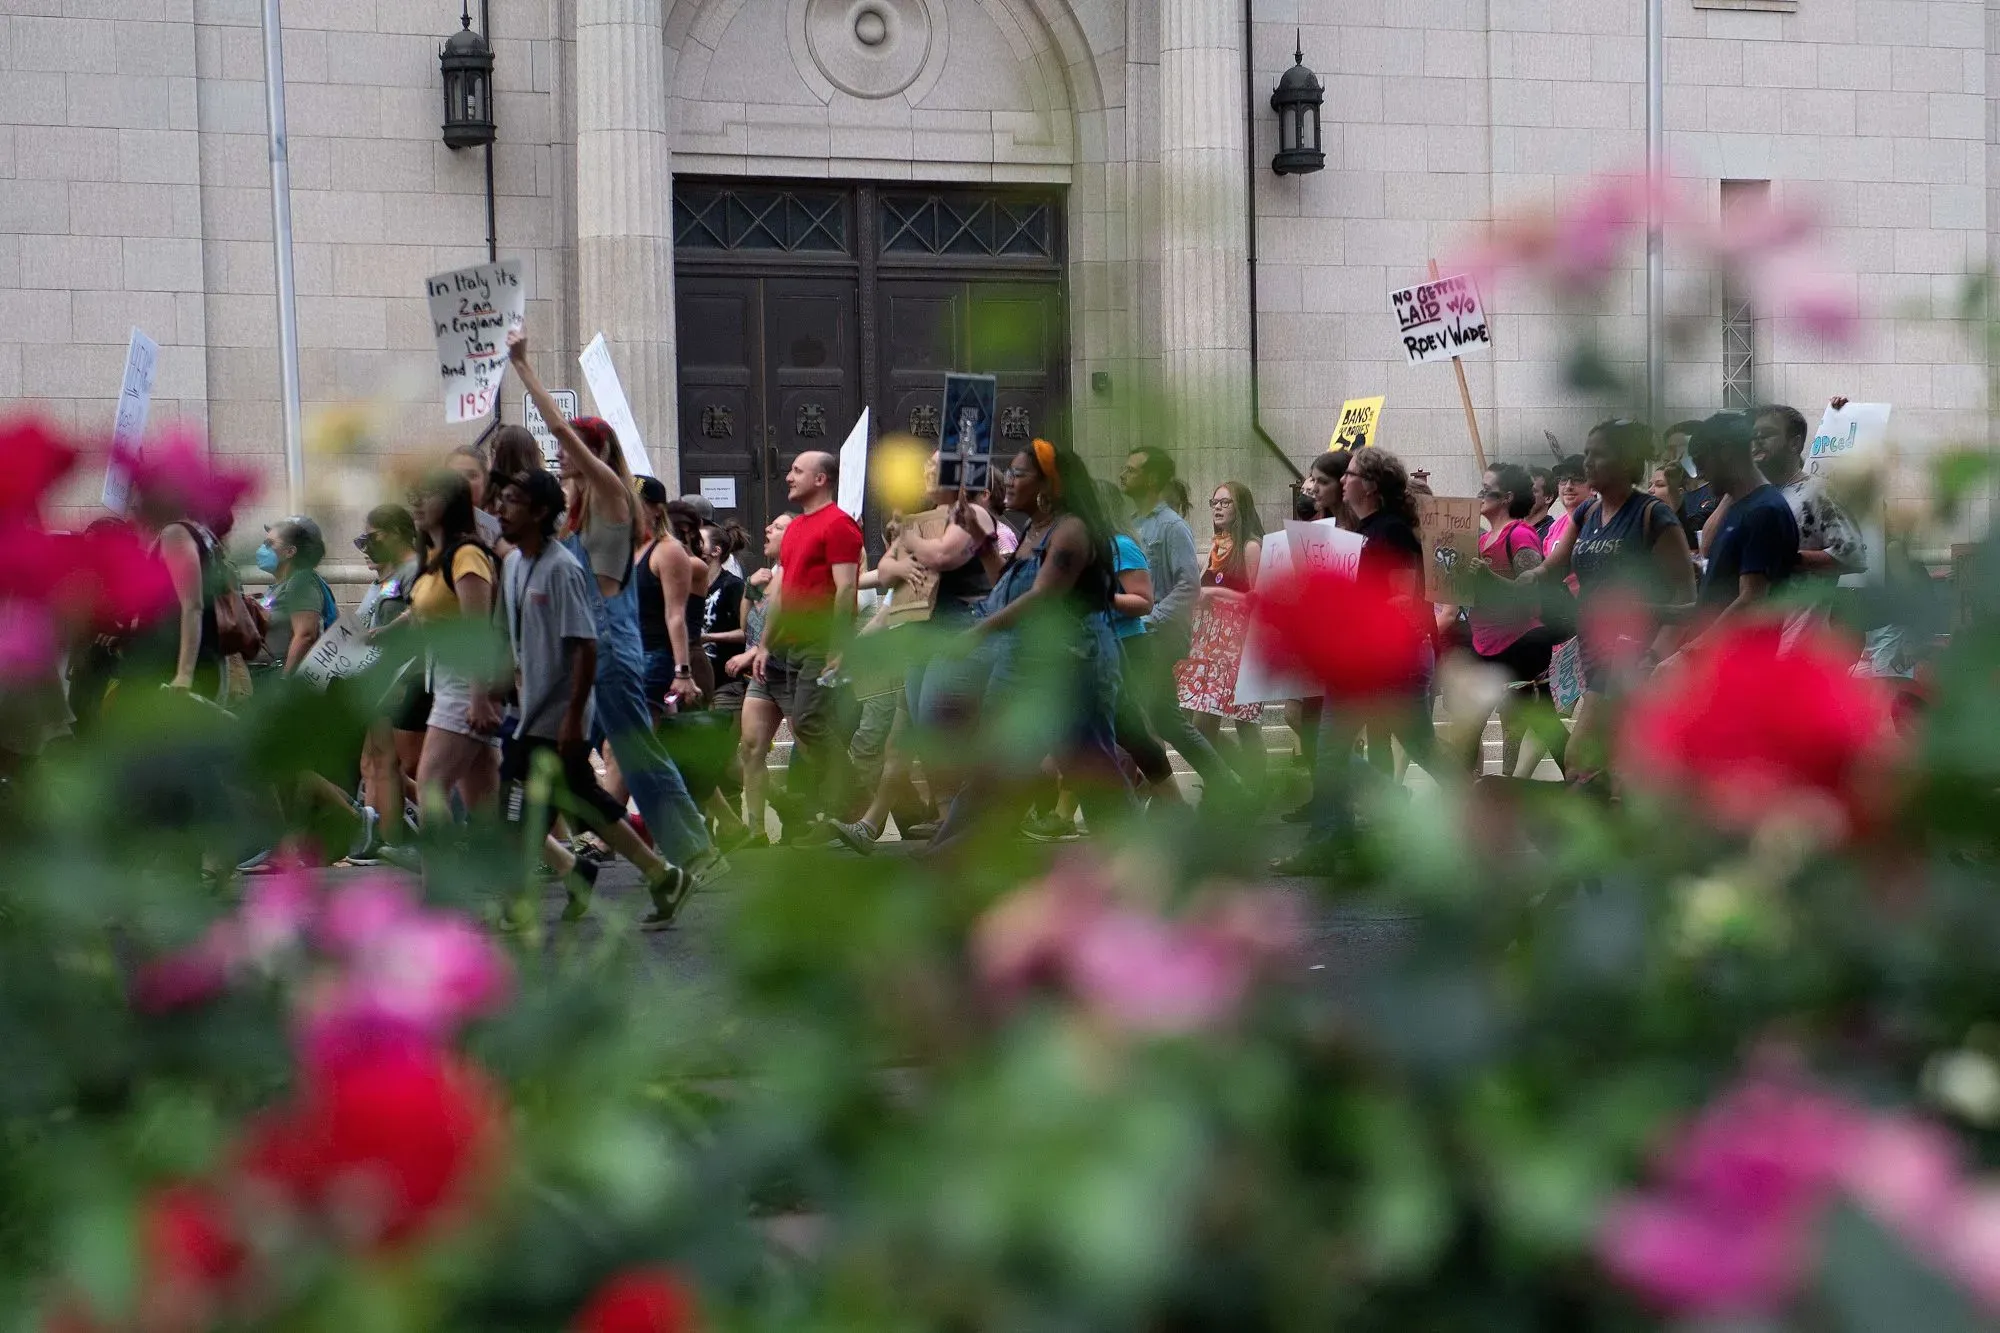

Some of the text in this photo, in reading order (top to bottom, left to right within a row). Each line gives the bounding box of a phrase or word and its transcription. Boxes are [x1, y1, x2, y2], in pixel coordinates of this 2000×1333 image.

[428, 280, 449, 297] In
[454, 269, 491, 300] Italy
[1392, 290, 1412, 306] NO
[1397, 301, 1441, 326] LAID
[452, 313, 504, 342] England
[1447, 316, 1489, 347] WADE
[441, 359, 467, 378] And
[1342, 406, 1371, 426] BANS
[313, 640, 339, 669] HAD
[338, 624, 353, 642] A
